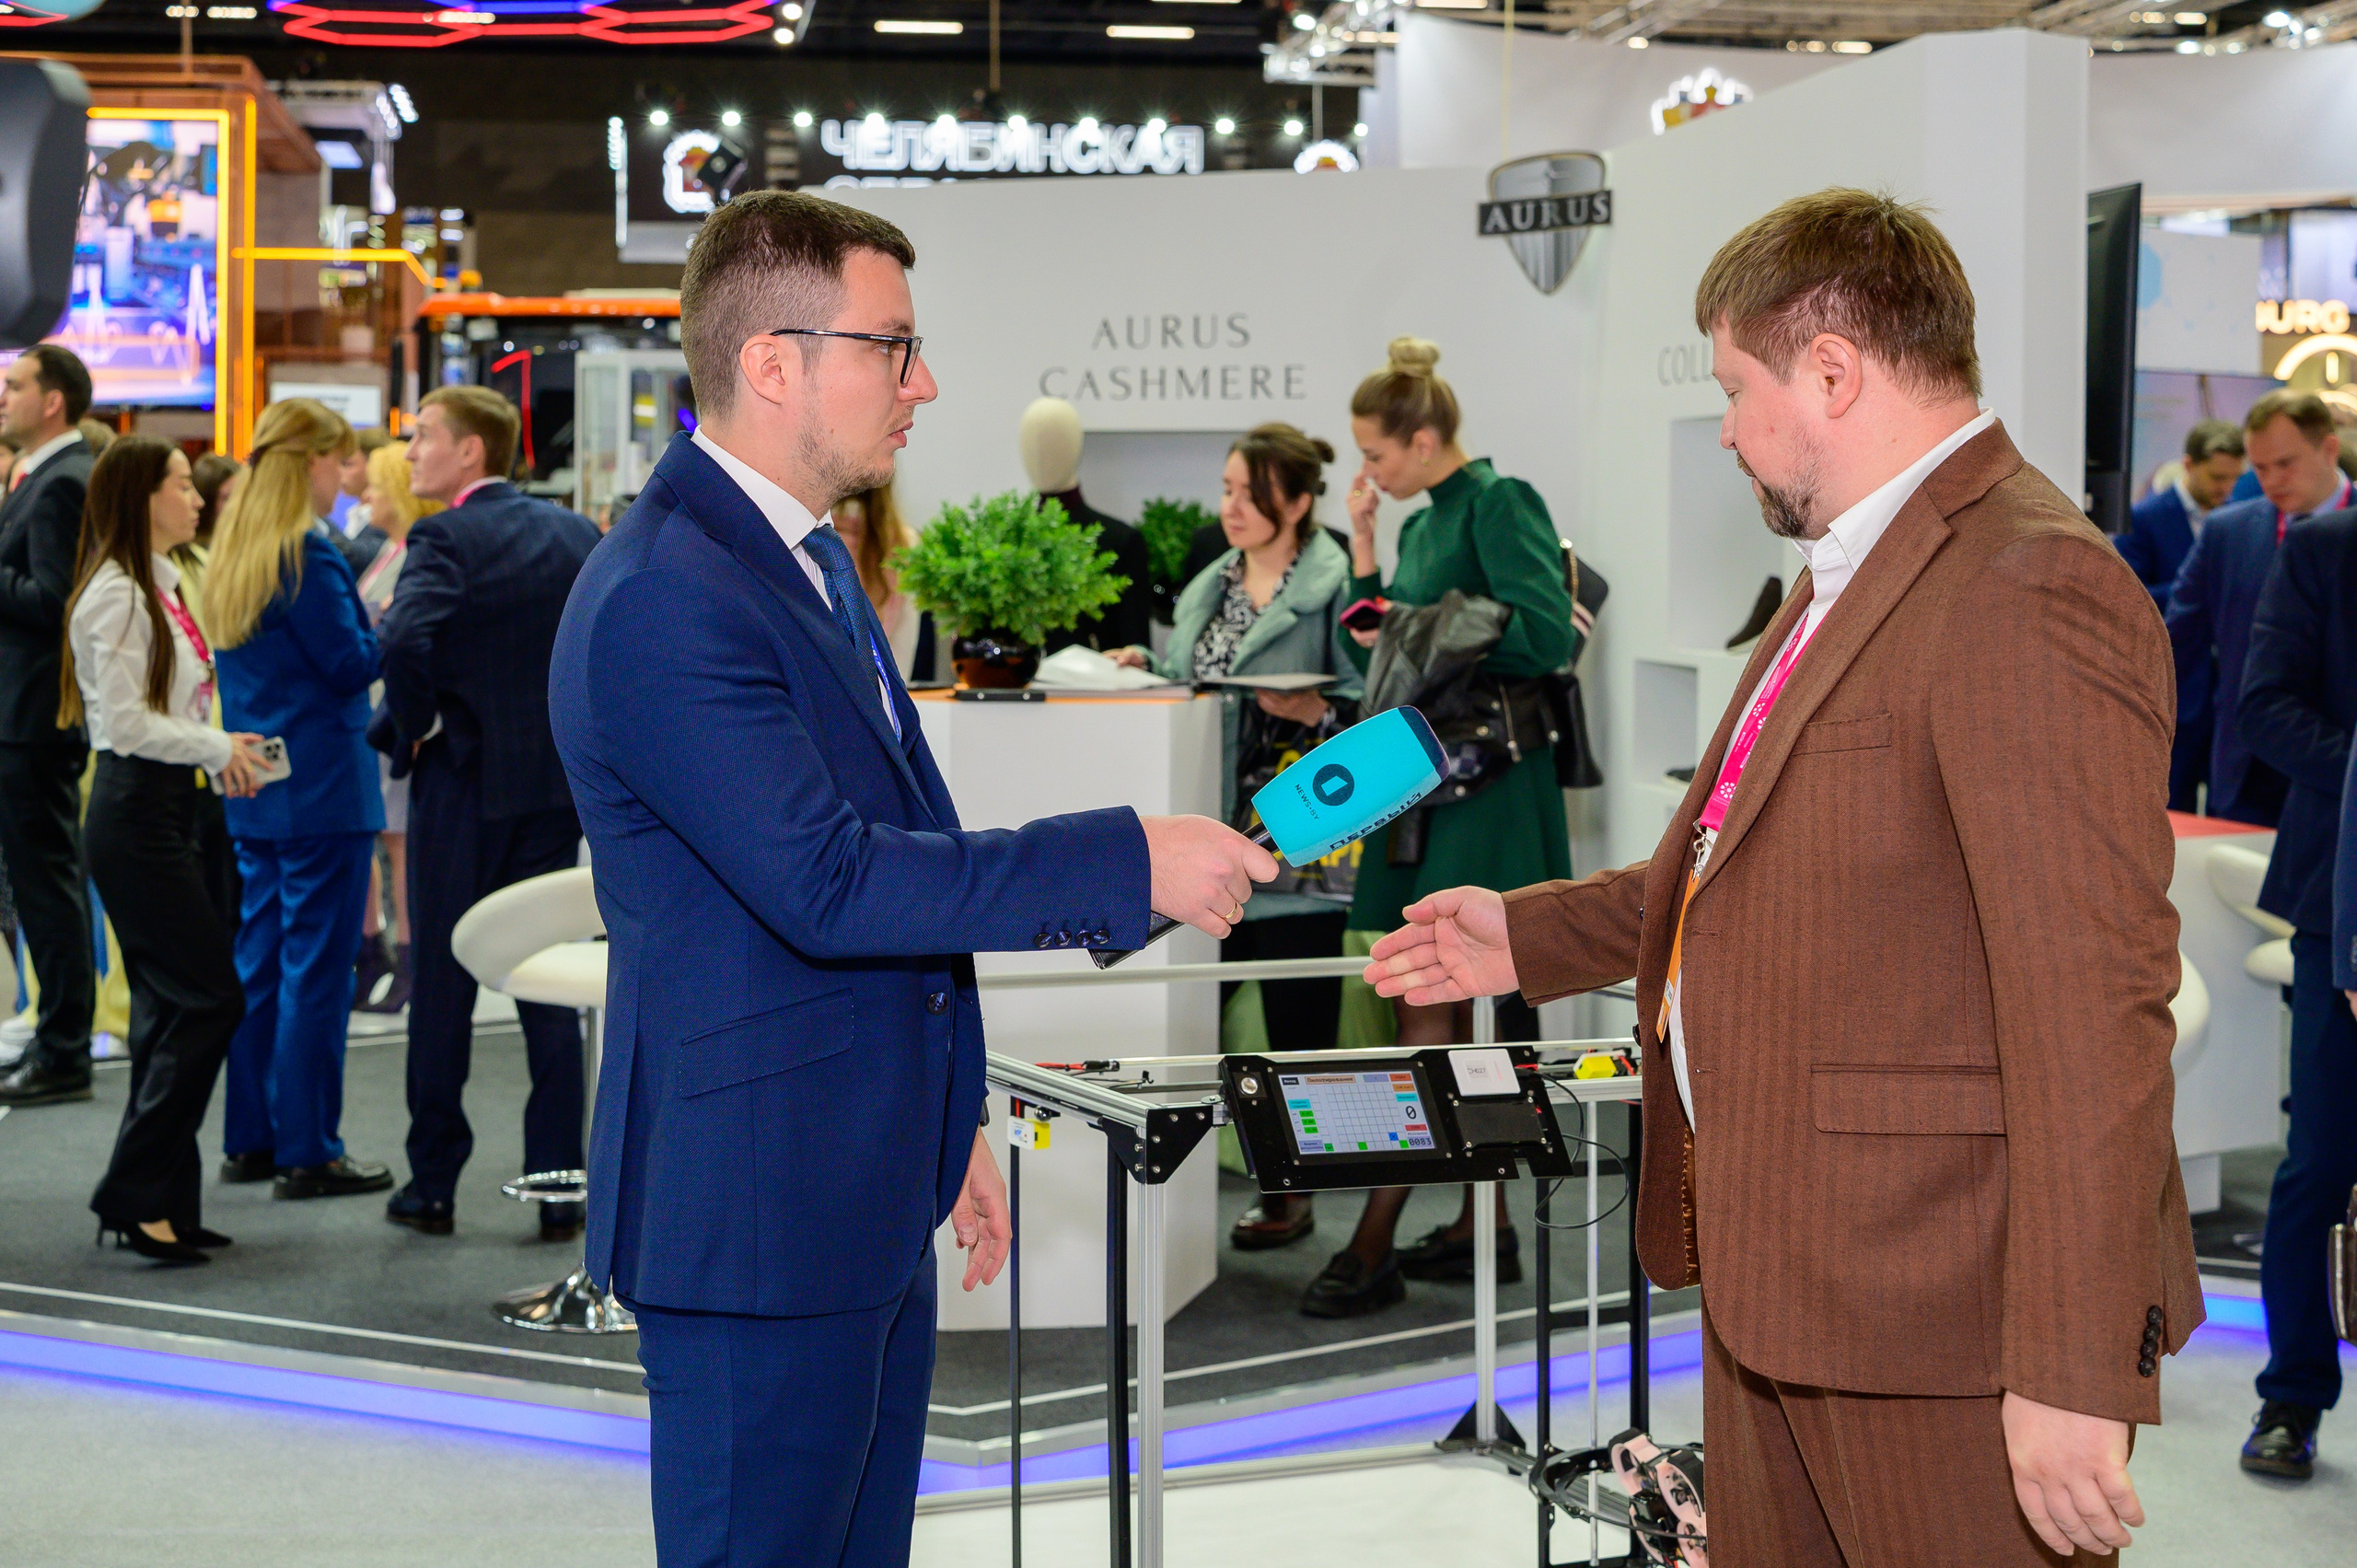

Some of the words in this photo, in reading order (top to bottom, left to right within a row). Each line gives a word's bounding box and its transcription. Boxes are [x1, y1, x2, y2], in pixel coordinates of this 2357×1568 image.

[821, 119, 1204, 175] ЧЕЛЯБИНСКАЯ
[1483, 192, 1609, 233] AURUS
[1091, 311, 1251, 351] AURUS
[1039, 364, 1307, 401] CASHMERE
[1408, 1137, 1433, 1146] 0083
